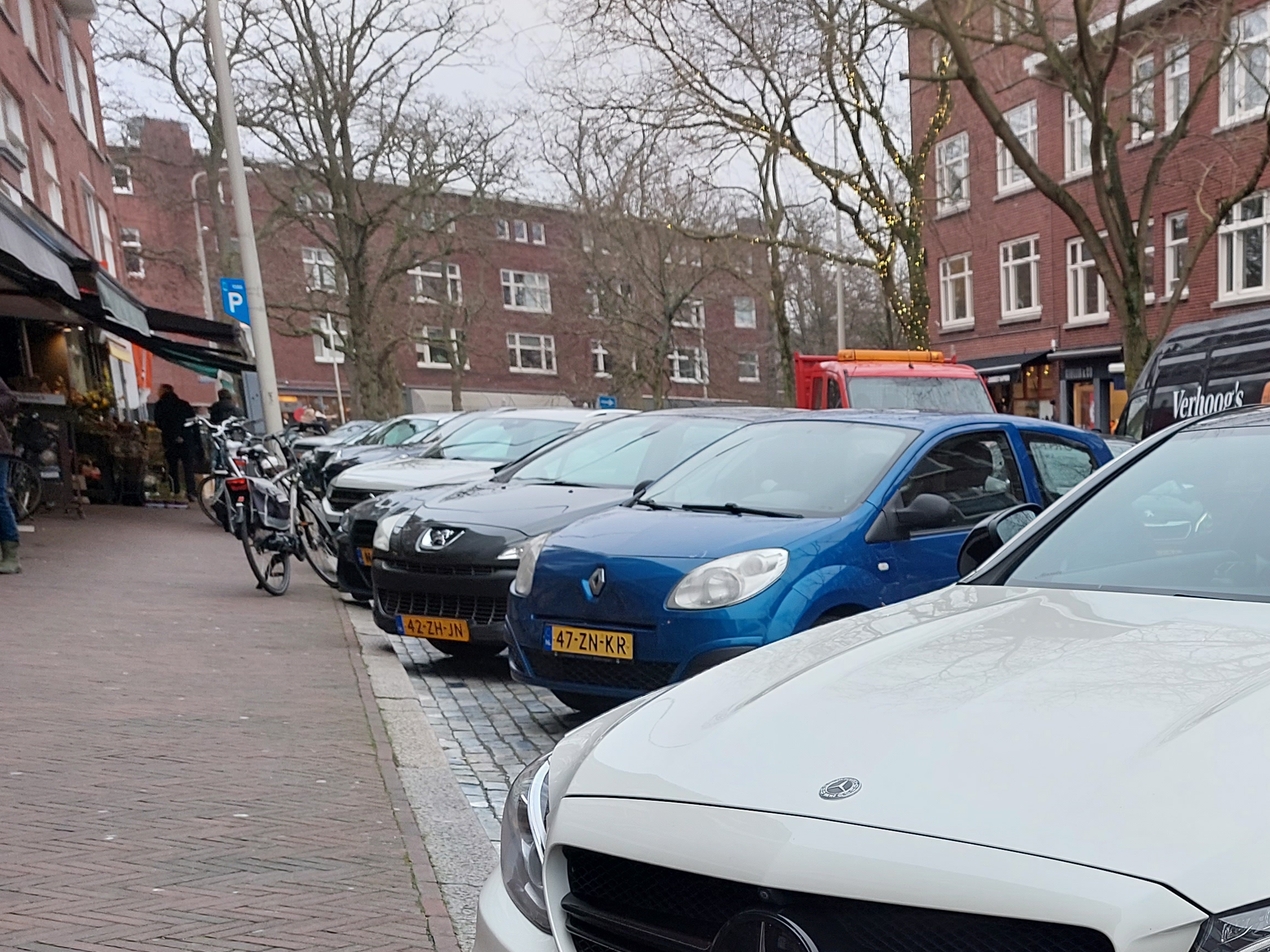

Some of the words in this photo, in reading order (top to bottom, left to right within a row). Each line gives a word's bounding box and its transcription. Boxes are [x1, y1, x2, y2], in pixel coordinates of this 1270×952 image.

[228, 291, 243, 313] P
[1173, 380, 1244, 419] Verhoog's
[407, 619, 464, 638] 42-ZH-JN
[556, 630, 626, 655] 47-ZN-KR
